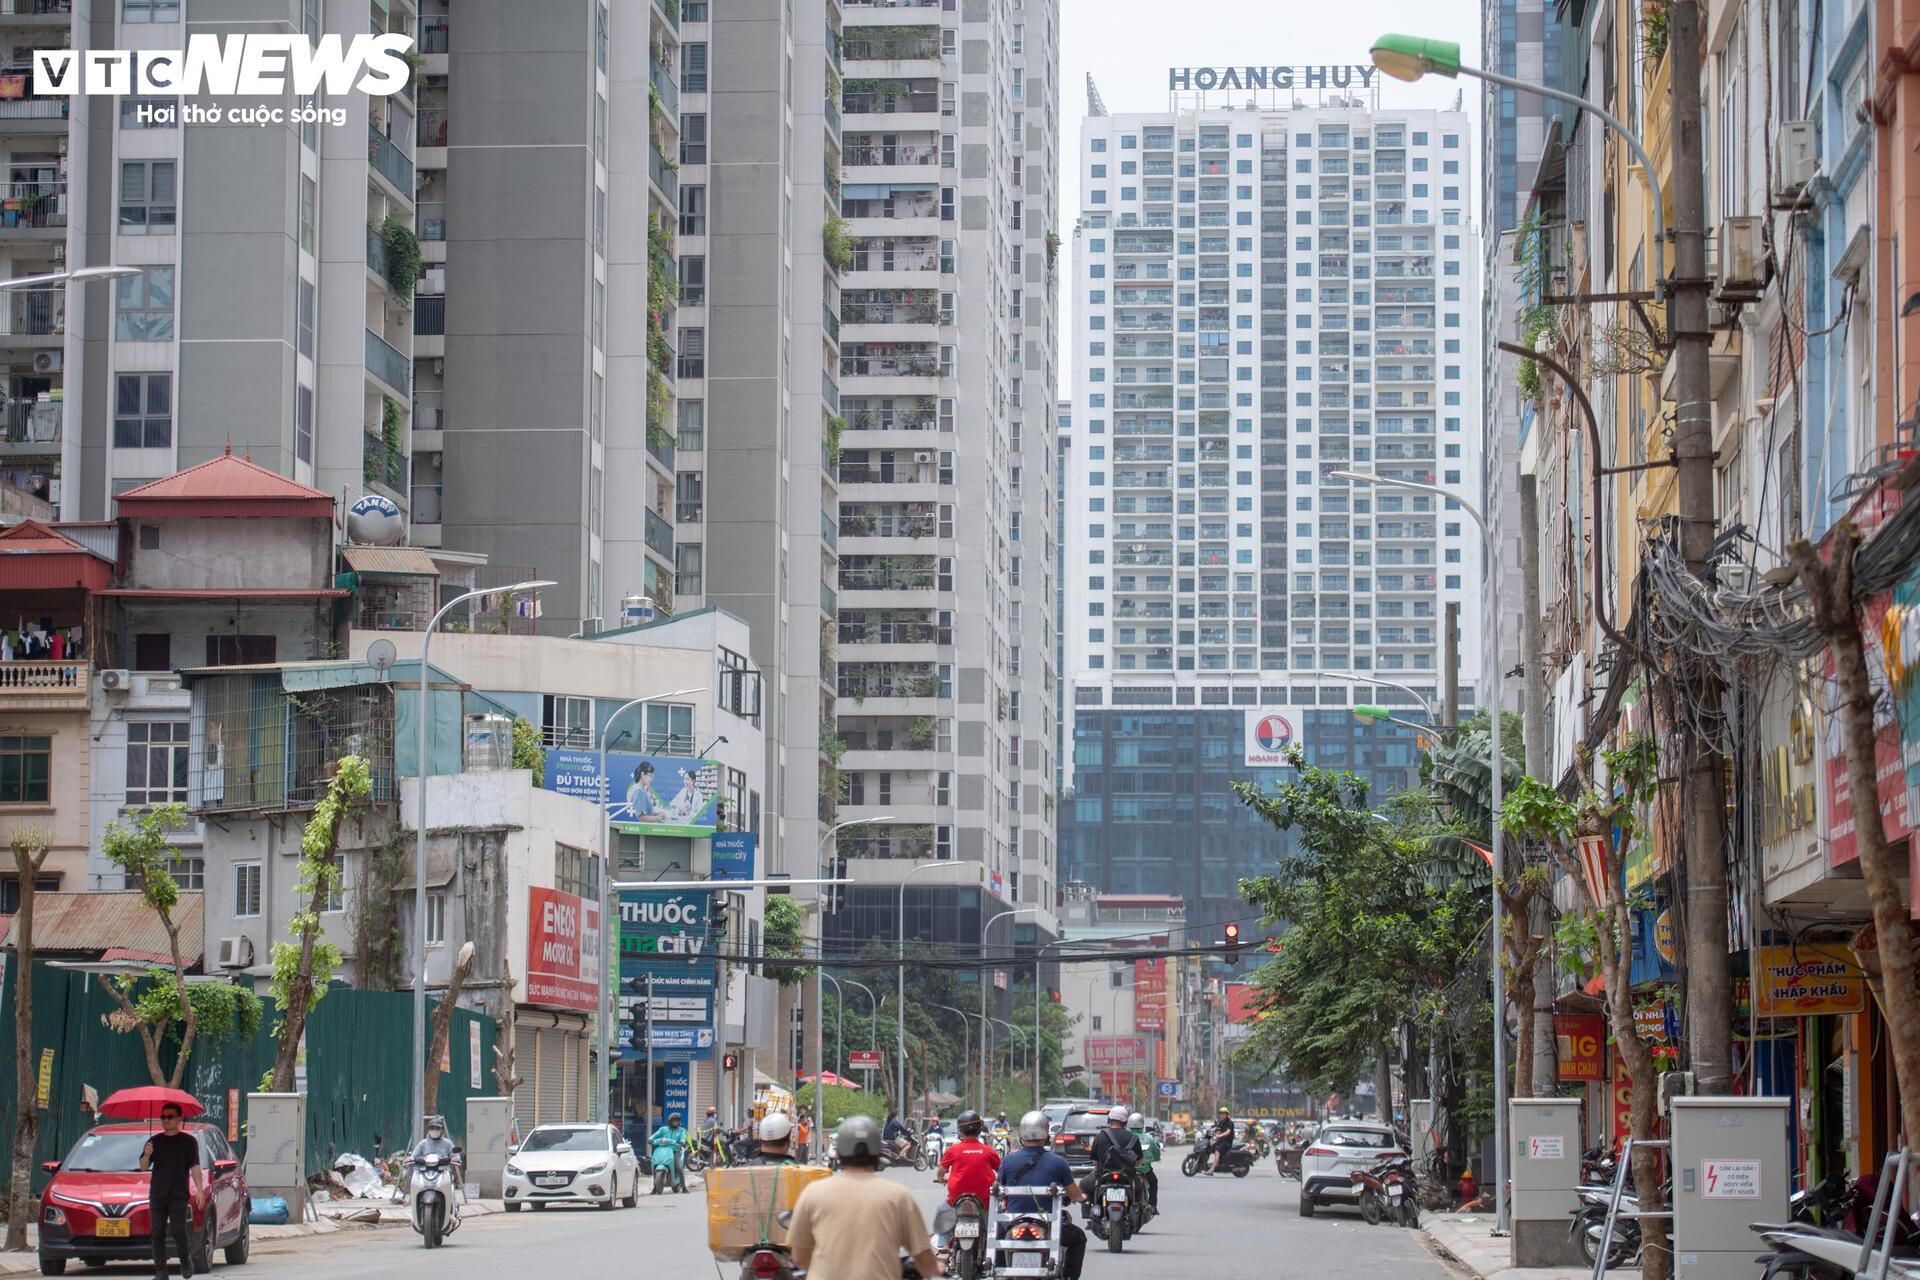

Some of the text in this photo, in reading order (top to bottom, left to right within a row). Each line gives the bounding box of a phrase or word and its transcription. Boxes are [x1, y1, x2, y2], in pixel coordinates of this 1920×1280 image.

[1169, 65, 1377, 91] HOANG HUY
[556, 772, 572, 786] ĐỦ
[543, 901, 576, 938] ENEOS
[619, 896, 697, 925] THUỐC
[619, 926, 705, 964] macity
